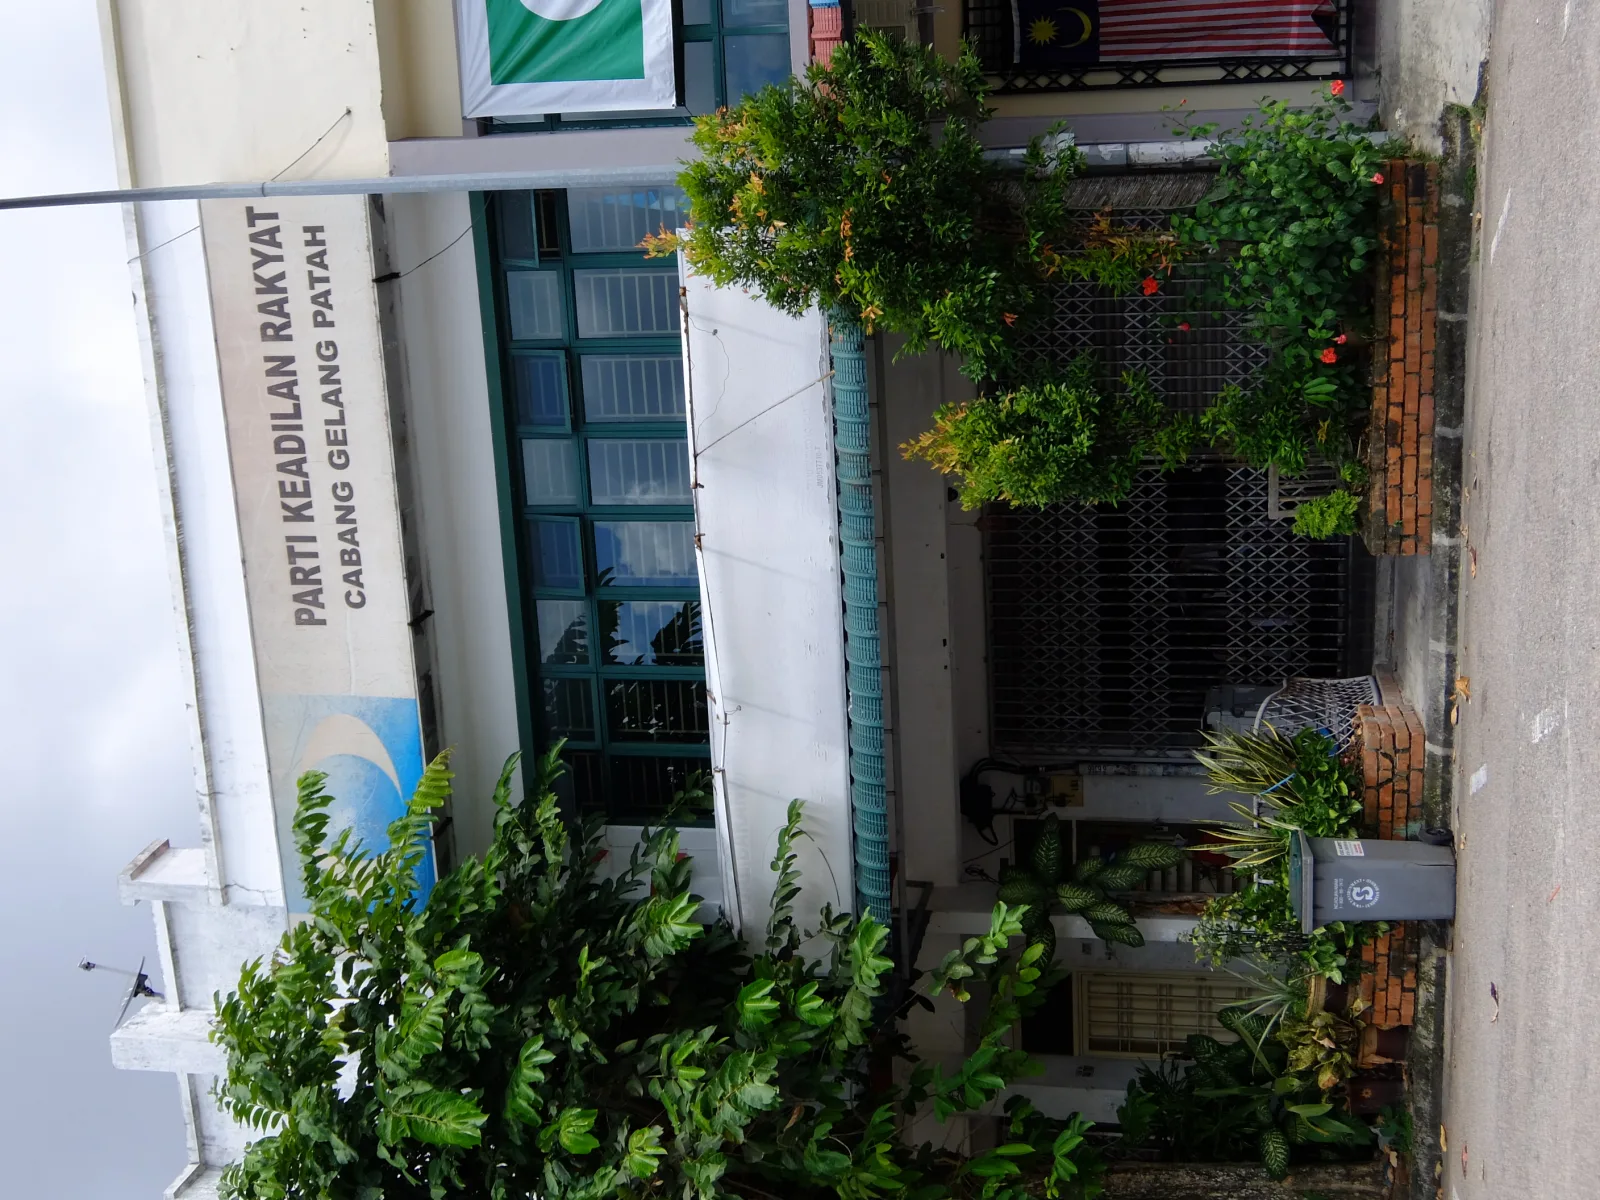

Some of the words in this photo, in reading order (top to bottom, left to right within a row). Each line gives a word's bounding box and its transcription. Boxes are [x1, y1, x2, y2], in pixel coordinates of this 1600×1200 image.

[245, 206, 294, 342] RAKYAT
[302, 225, 335, 328] PATAH
[263, 355, 315, 522] KEADILAN
[315, 340, 350, 470] GELANG
[285, 535, 327, 626] PARTI
[331, 481, 367, 609] CABANG
